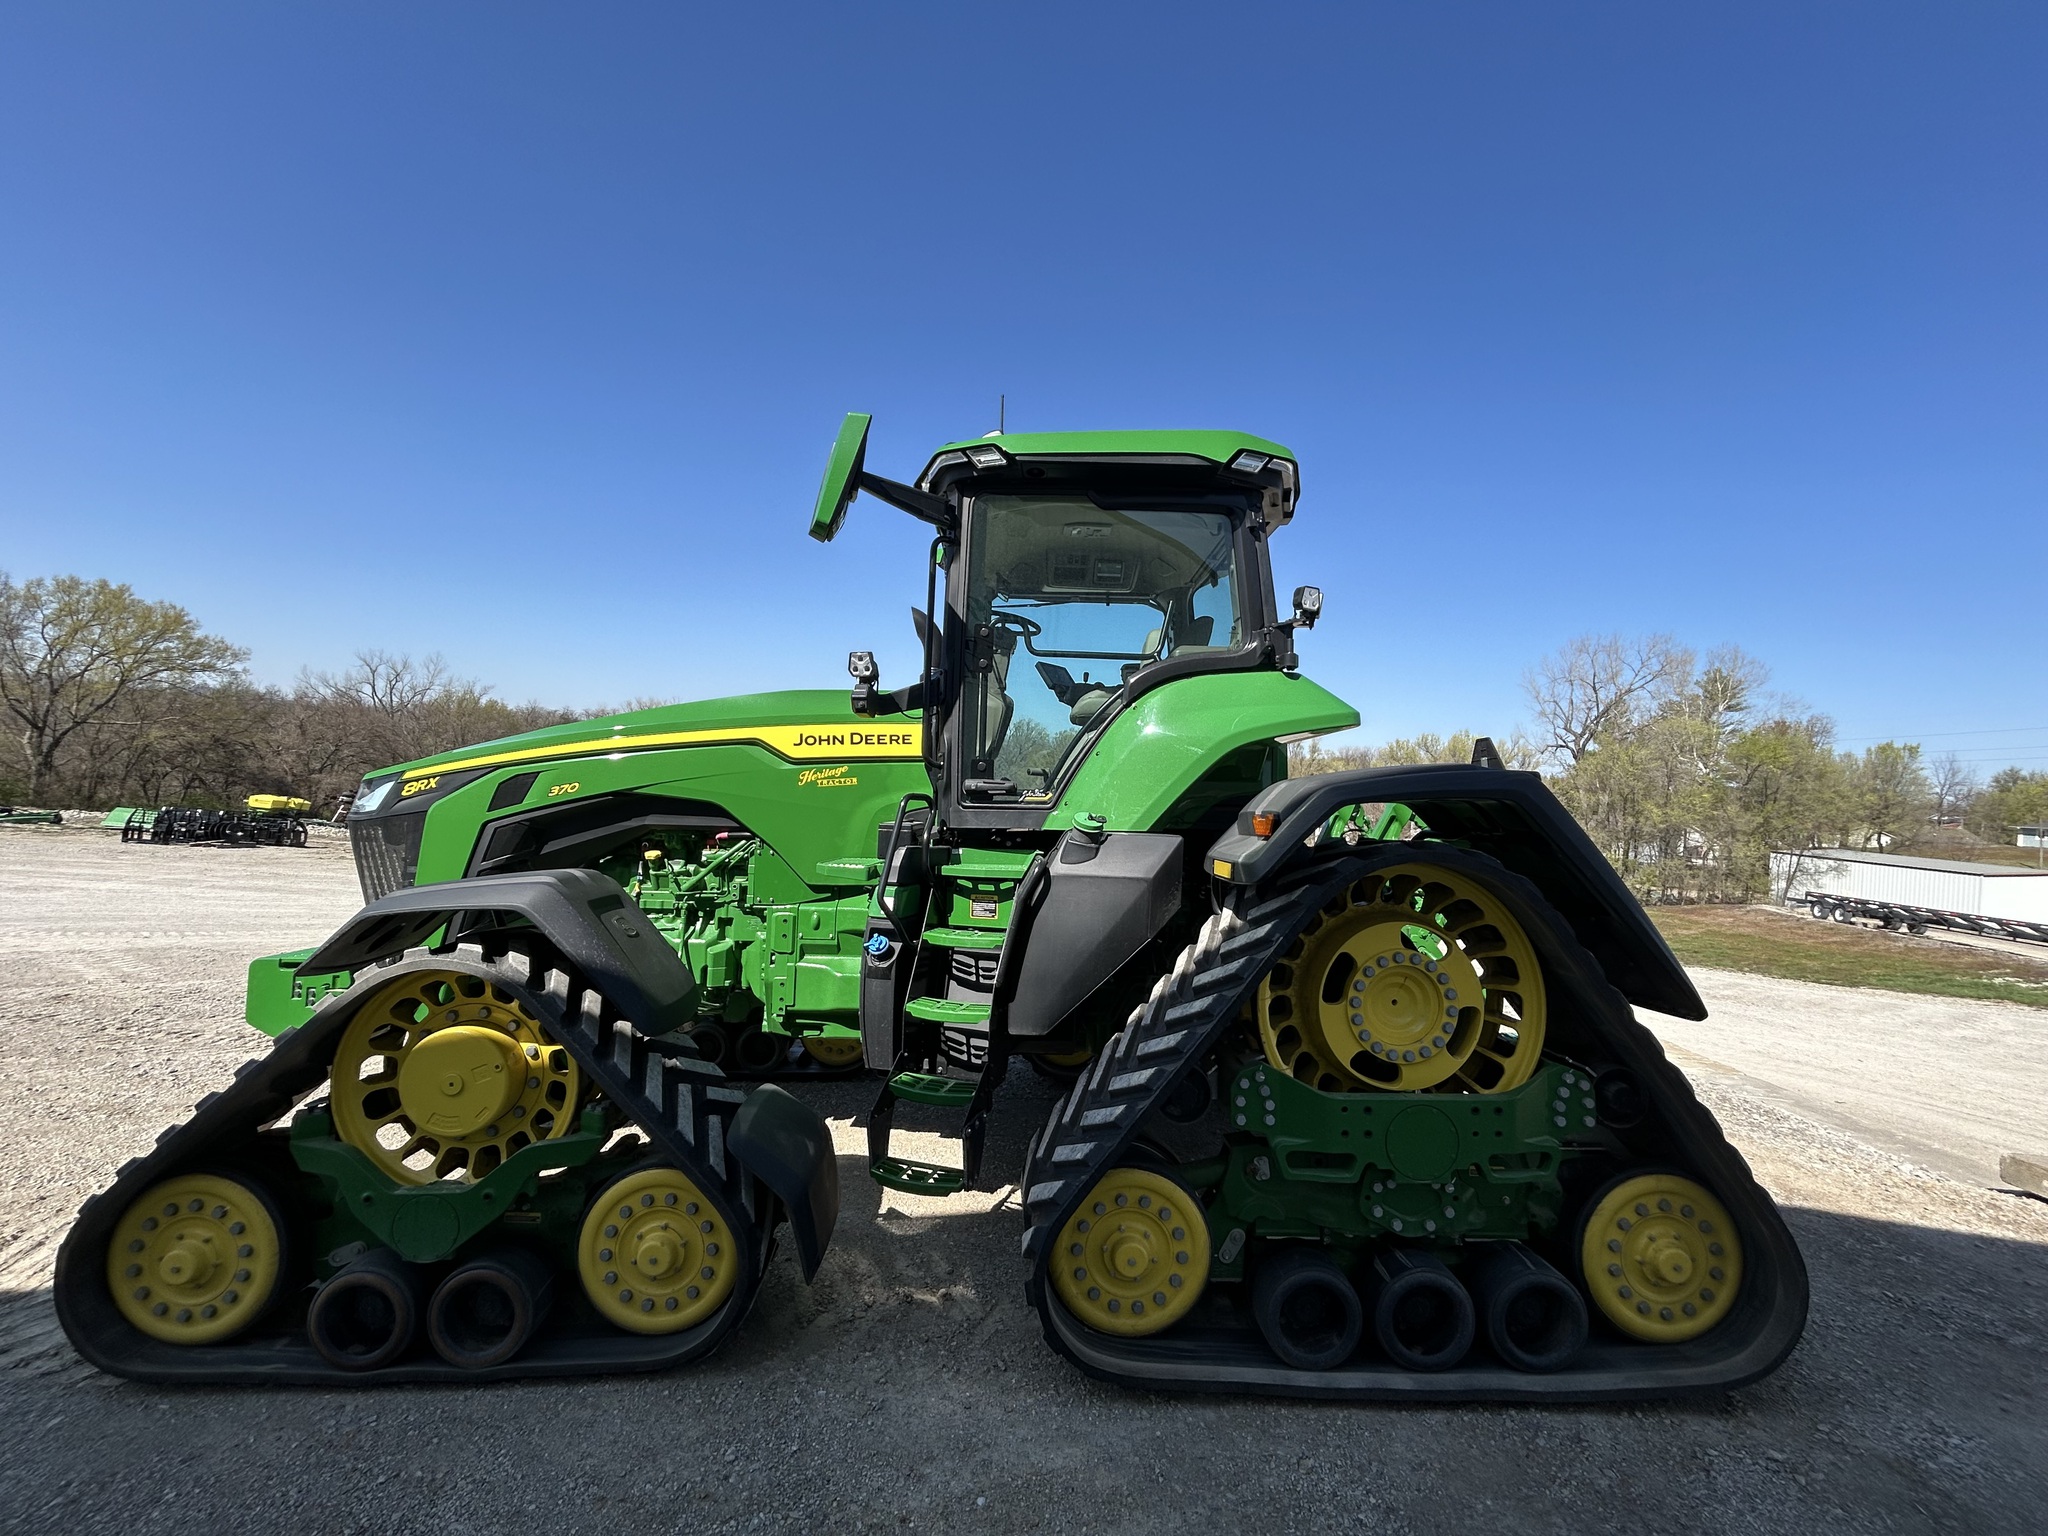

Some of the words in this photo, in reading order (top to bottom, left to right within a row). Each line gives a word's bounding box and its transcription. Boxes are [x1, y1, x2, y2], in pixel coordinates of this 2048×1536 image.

[793, 733, 845, 746] JOHN
[850, 732, 913, 745] DEERE
[798, 765, 849, 786] Heritage
[817, 778, 858, 787] TRACTOR
[401, 776, 441, 796] 8RX
[548, 782, 580, 796] 370
